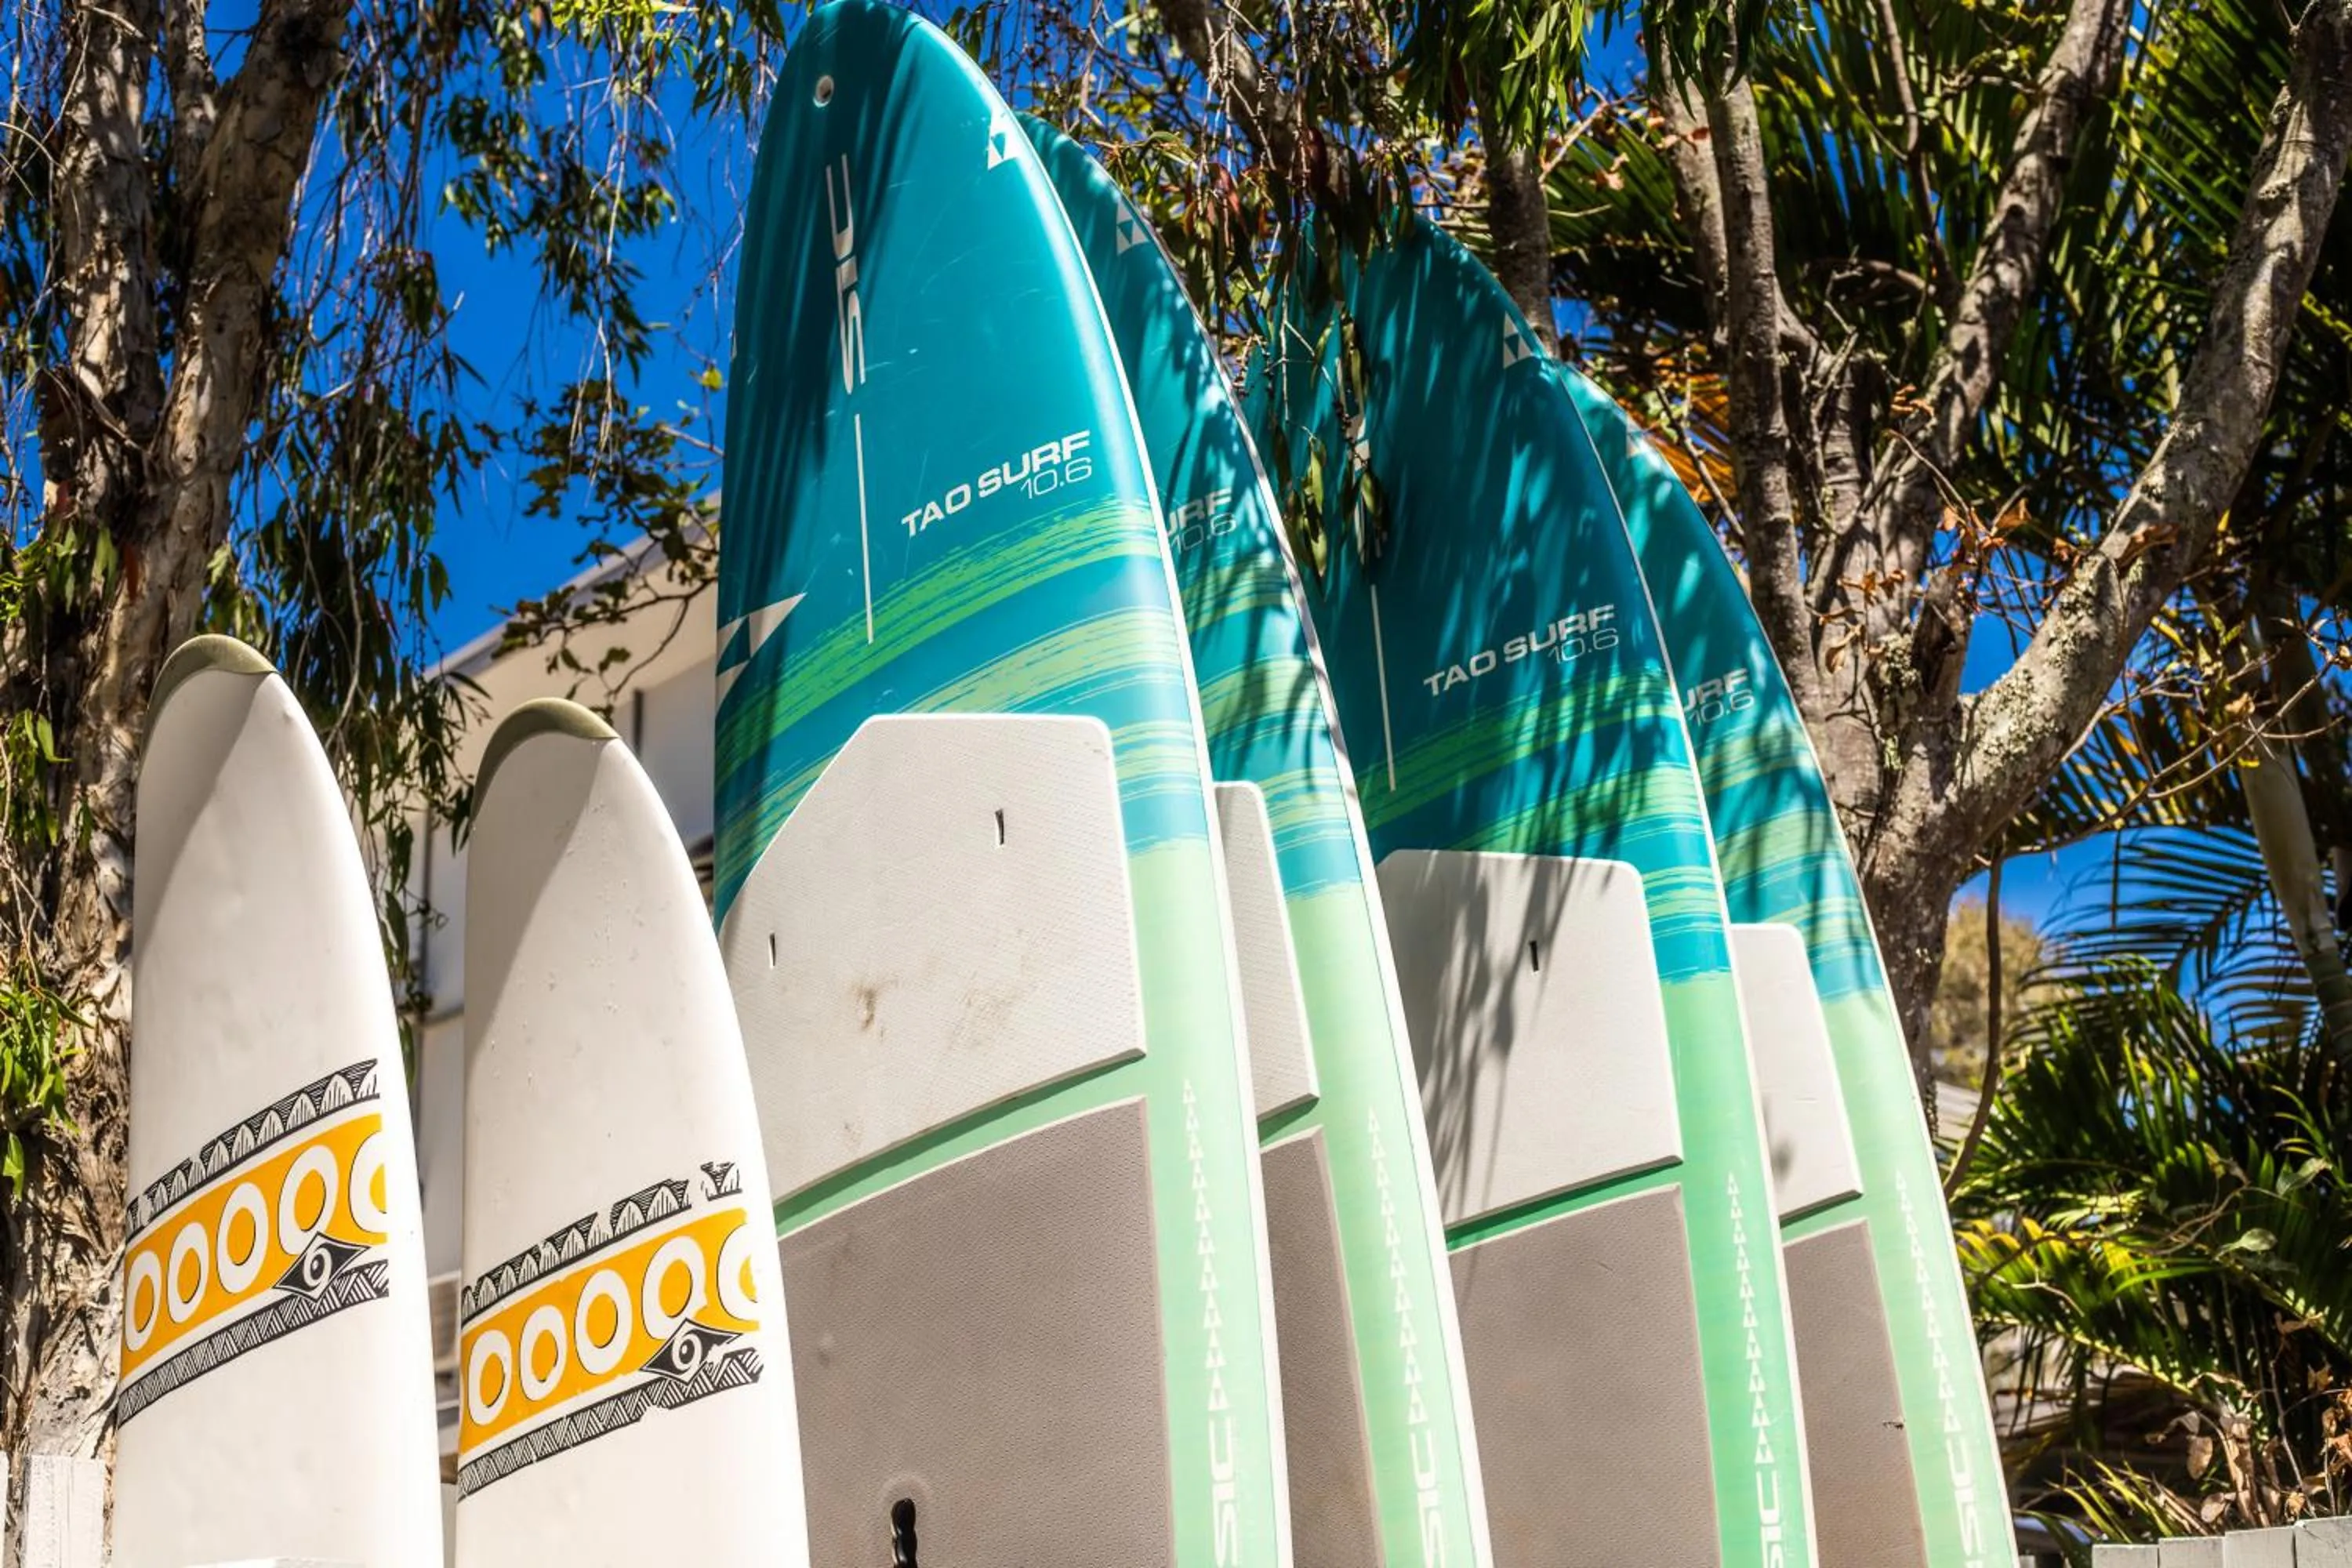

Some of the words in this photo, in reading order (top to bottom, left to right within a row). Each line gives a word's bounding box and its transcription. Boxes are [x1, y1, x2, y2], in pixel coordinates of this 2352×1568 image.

[902, 483, 971, 539] TAO
[978, 430, 1091, 499] SURF
[1021, 457, 1092, 499] 10.6
[1171, 512, 1236, 555] 10.6
[1423, 649, 1497, 697] TAO
[1504, 604, 1615, 663] SURF
[1548, 626, 1619, 665] 10.6
[1688, 688, 1755, 728] 10.6
